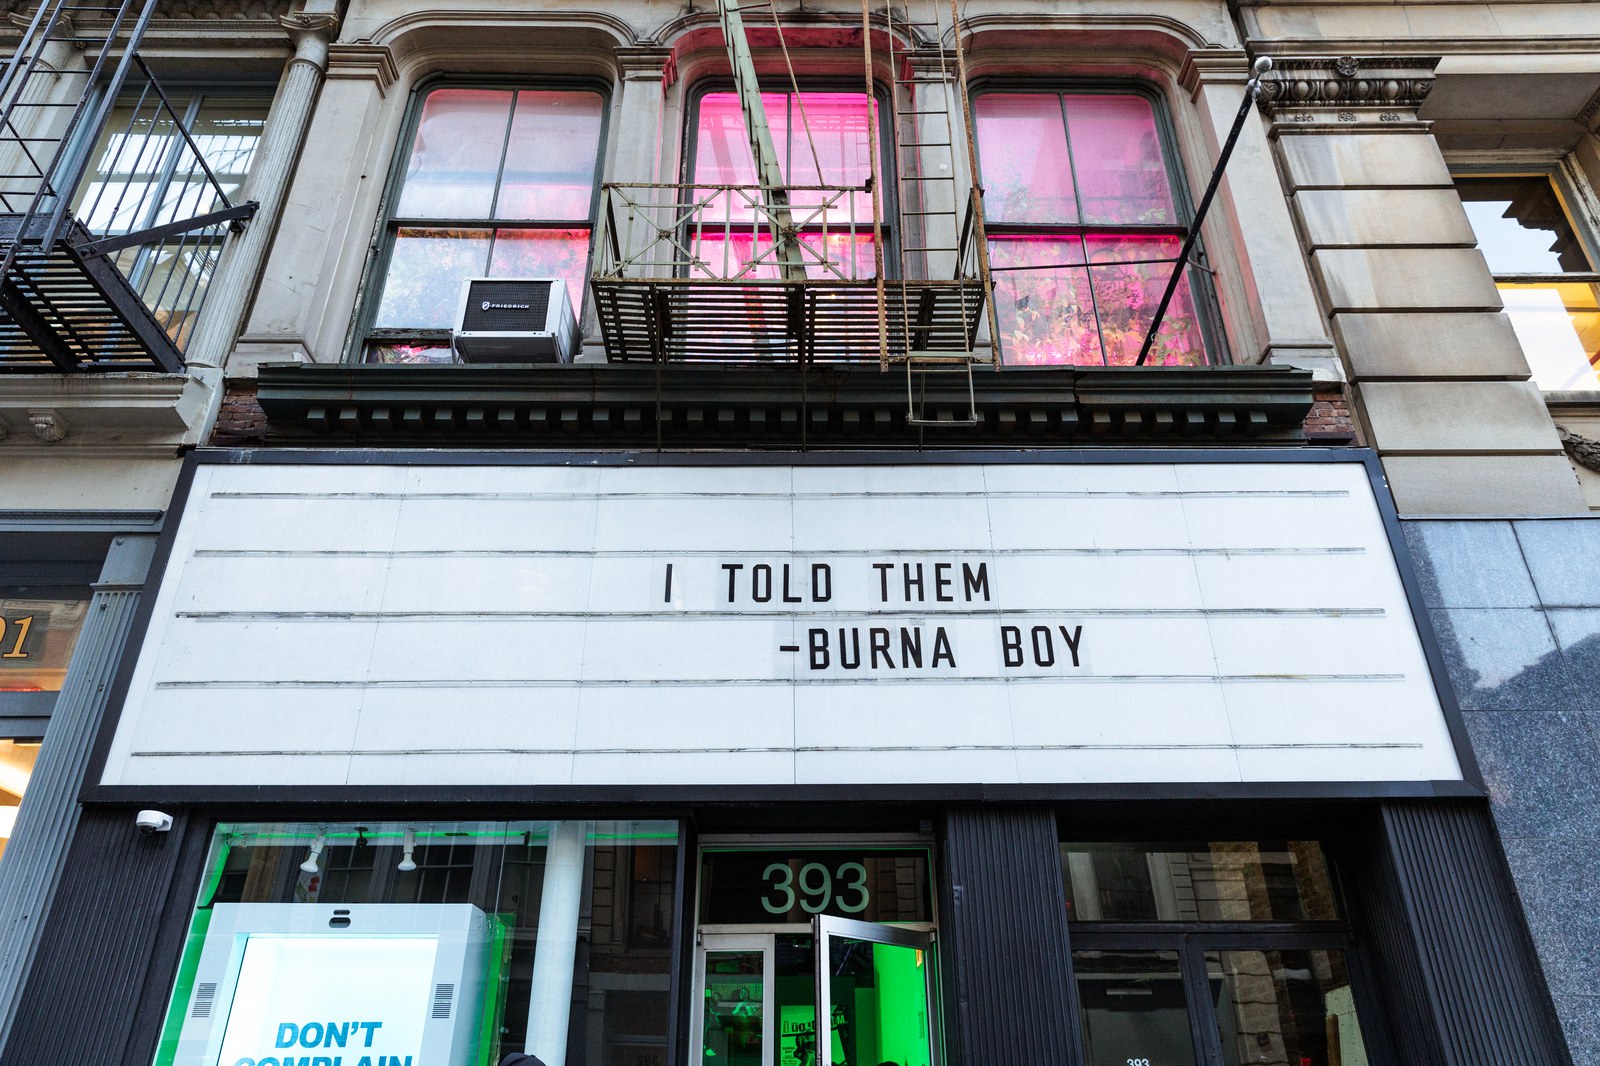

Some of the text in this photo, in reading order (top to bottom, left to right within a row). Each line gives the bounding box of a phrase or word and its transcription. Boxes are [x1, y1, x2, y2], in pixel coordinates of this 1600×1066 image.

[664, 562, 991, 603] I TOLD THEM
[0, 615, 33, 658] 1
[779, 625, 1083, 670] -BURNA BOY
[761, 862, 870, 915] 393
[275, 1021, 383, 1049] DON'T
[1126, 1058, 1150, 1066] 393
